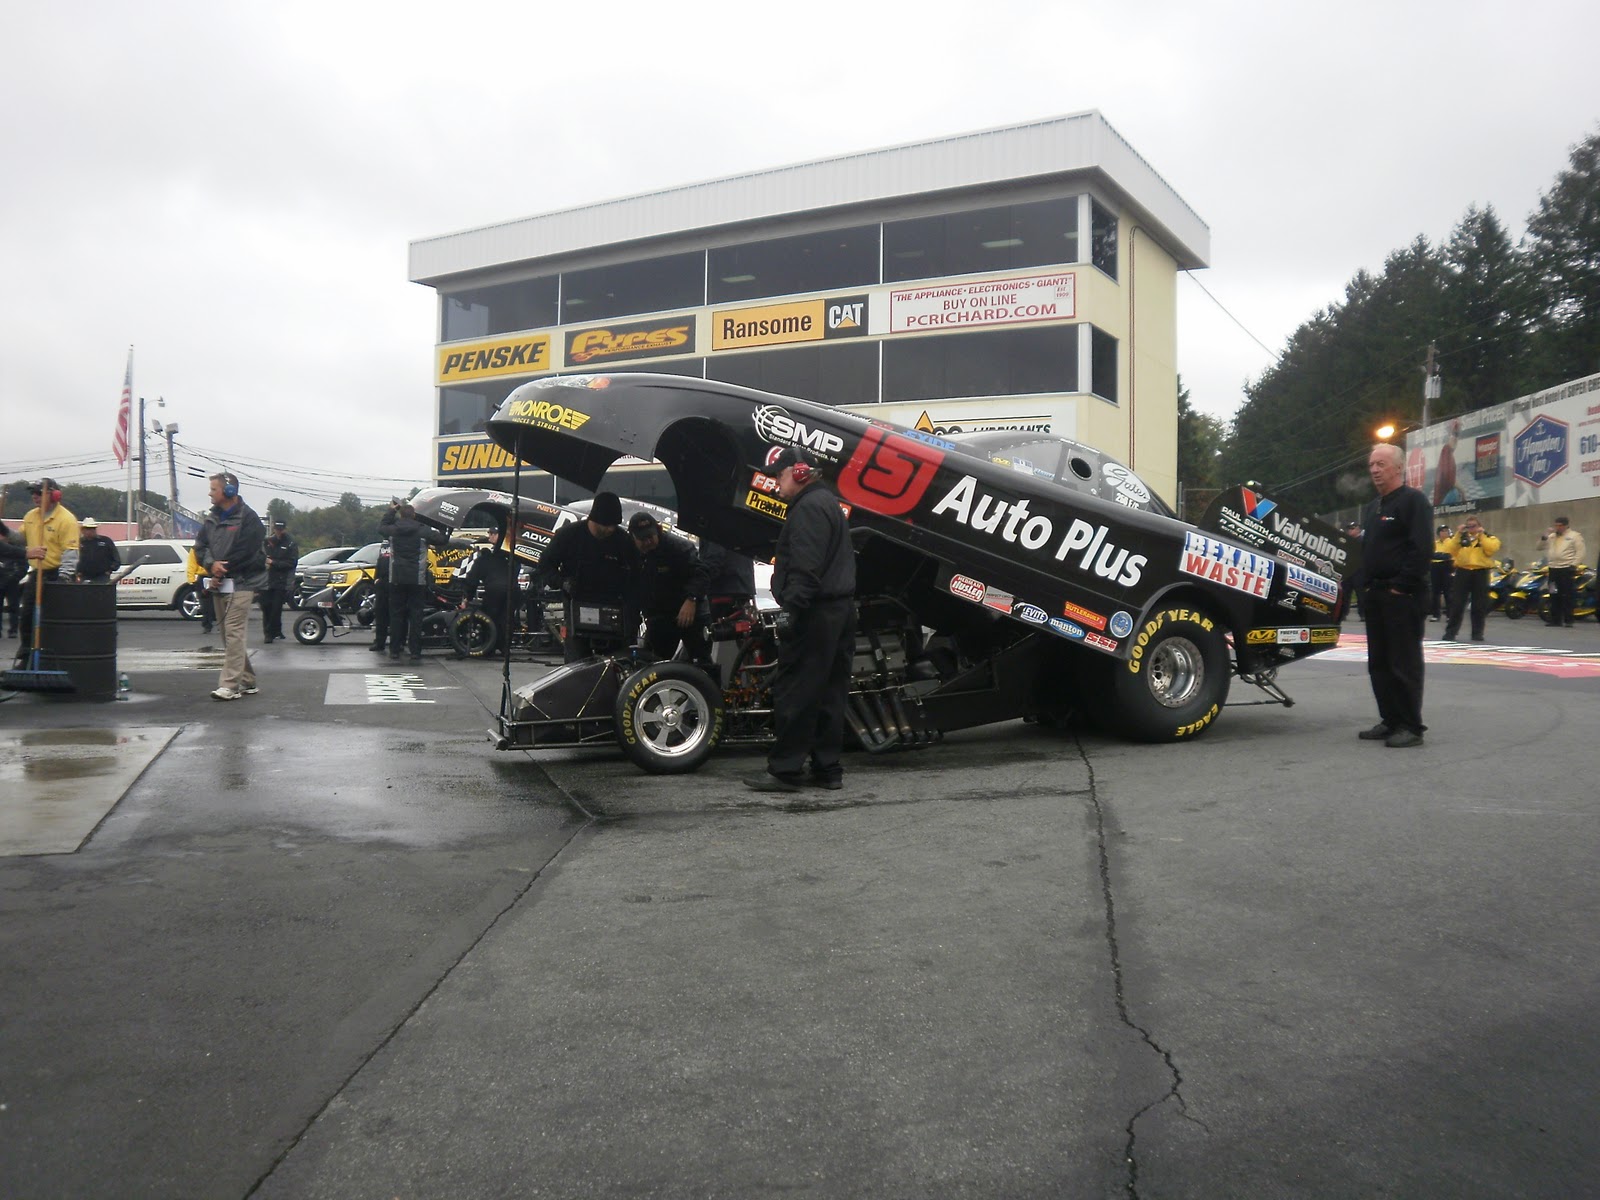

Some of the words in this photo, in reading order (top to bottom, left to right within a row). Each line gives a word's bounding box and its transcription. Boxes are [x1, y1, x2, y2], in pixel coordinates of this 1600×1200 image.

[915, 288, 962, 300] APPLIANCE
[968, 282, 1031, 294] ELECTRONICS
[943, 298, 967, 310] BUY
[970, 297, 989, 308] ON
[991, 294, 1017, 306] LINE
[723, 315, 812, 340] Ransome
[829, 303, 863, 329] CAT
[906, 303, 1057, 327] PCRICHARD.COM
[442, 341, 547, 375] PENSKE
[509, 400, 573, 428] MONROE
[769, 434, 791, 447] Standard
[770, 415, 844, 453] SMP
[442, 443, 531, 471] SUNO
[536, 504, 560, 515] NEW
[1221, 506, 1242, 522] PAUL
[1244, 518, 1270, 537] SMITH
[932, 475, 1053, 550] Auto
[1055, 518, 1148, 587] Plus
[1219, 519, 1265, 545] RACING
[1274, 512, 1348, 564] Valvoline
[1186, 532, 1274, 580] BEXAR
[1267, 533, 1318, 562] GOODYEAR
[1186, 553, 1267, 596] WASTE
[1288, 566, 1337, 593] Strange
[1050, 618, 1083, 636] manton
[1128, 609, 1214, 674] GOODYEAR
[622, 671, 658, 745] GOODYEAR
[1175, 703, 1219, 737] EAGLE
[707, 707, 723, 747] EAGLE
